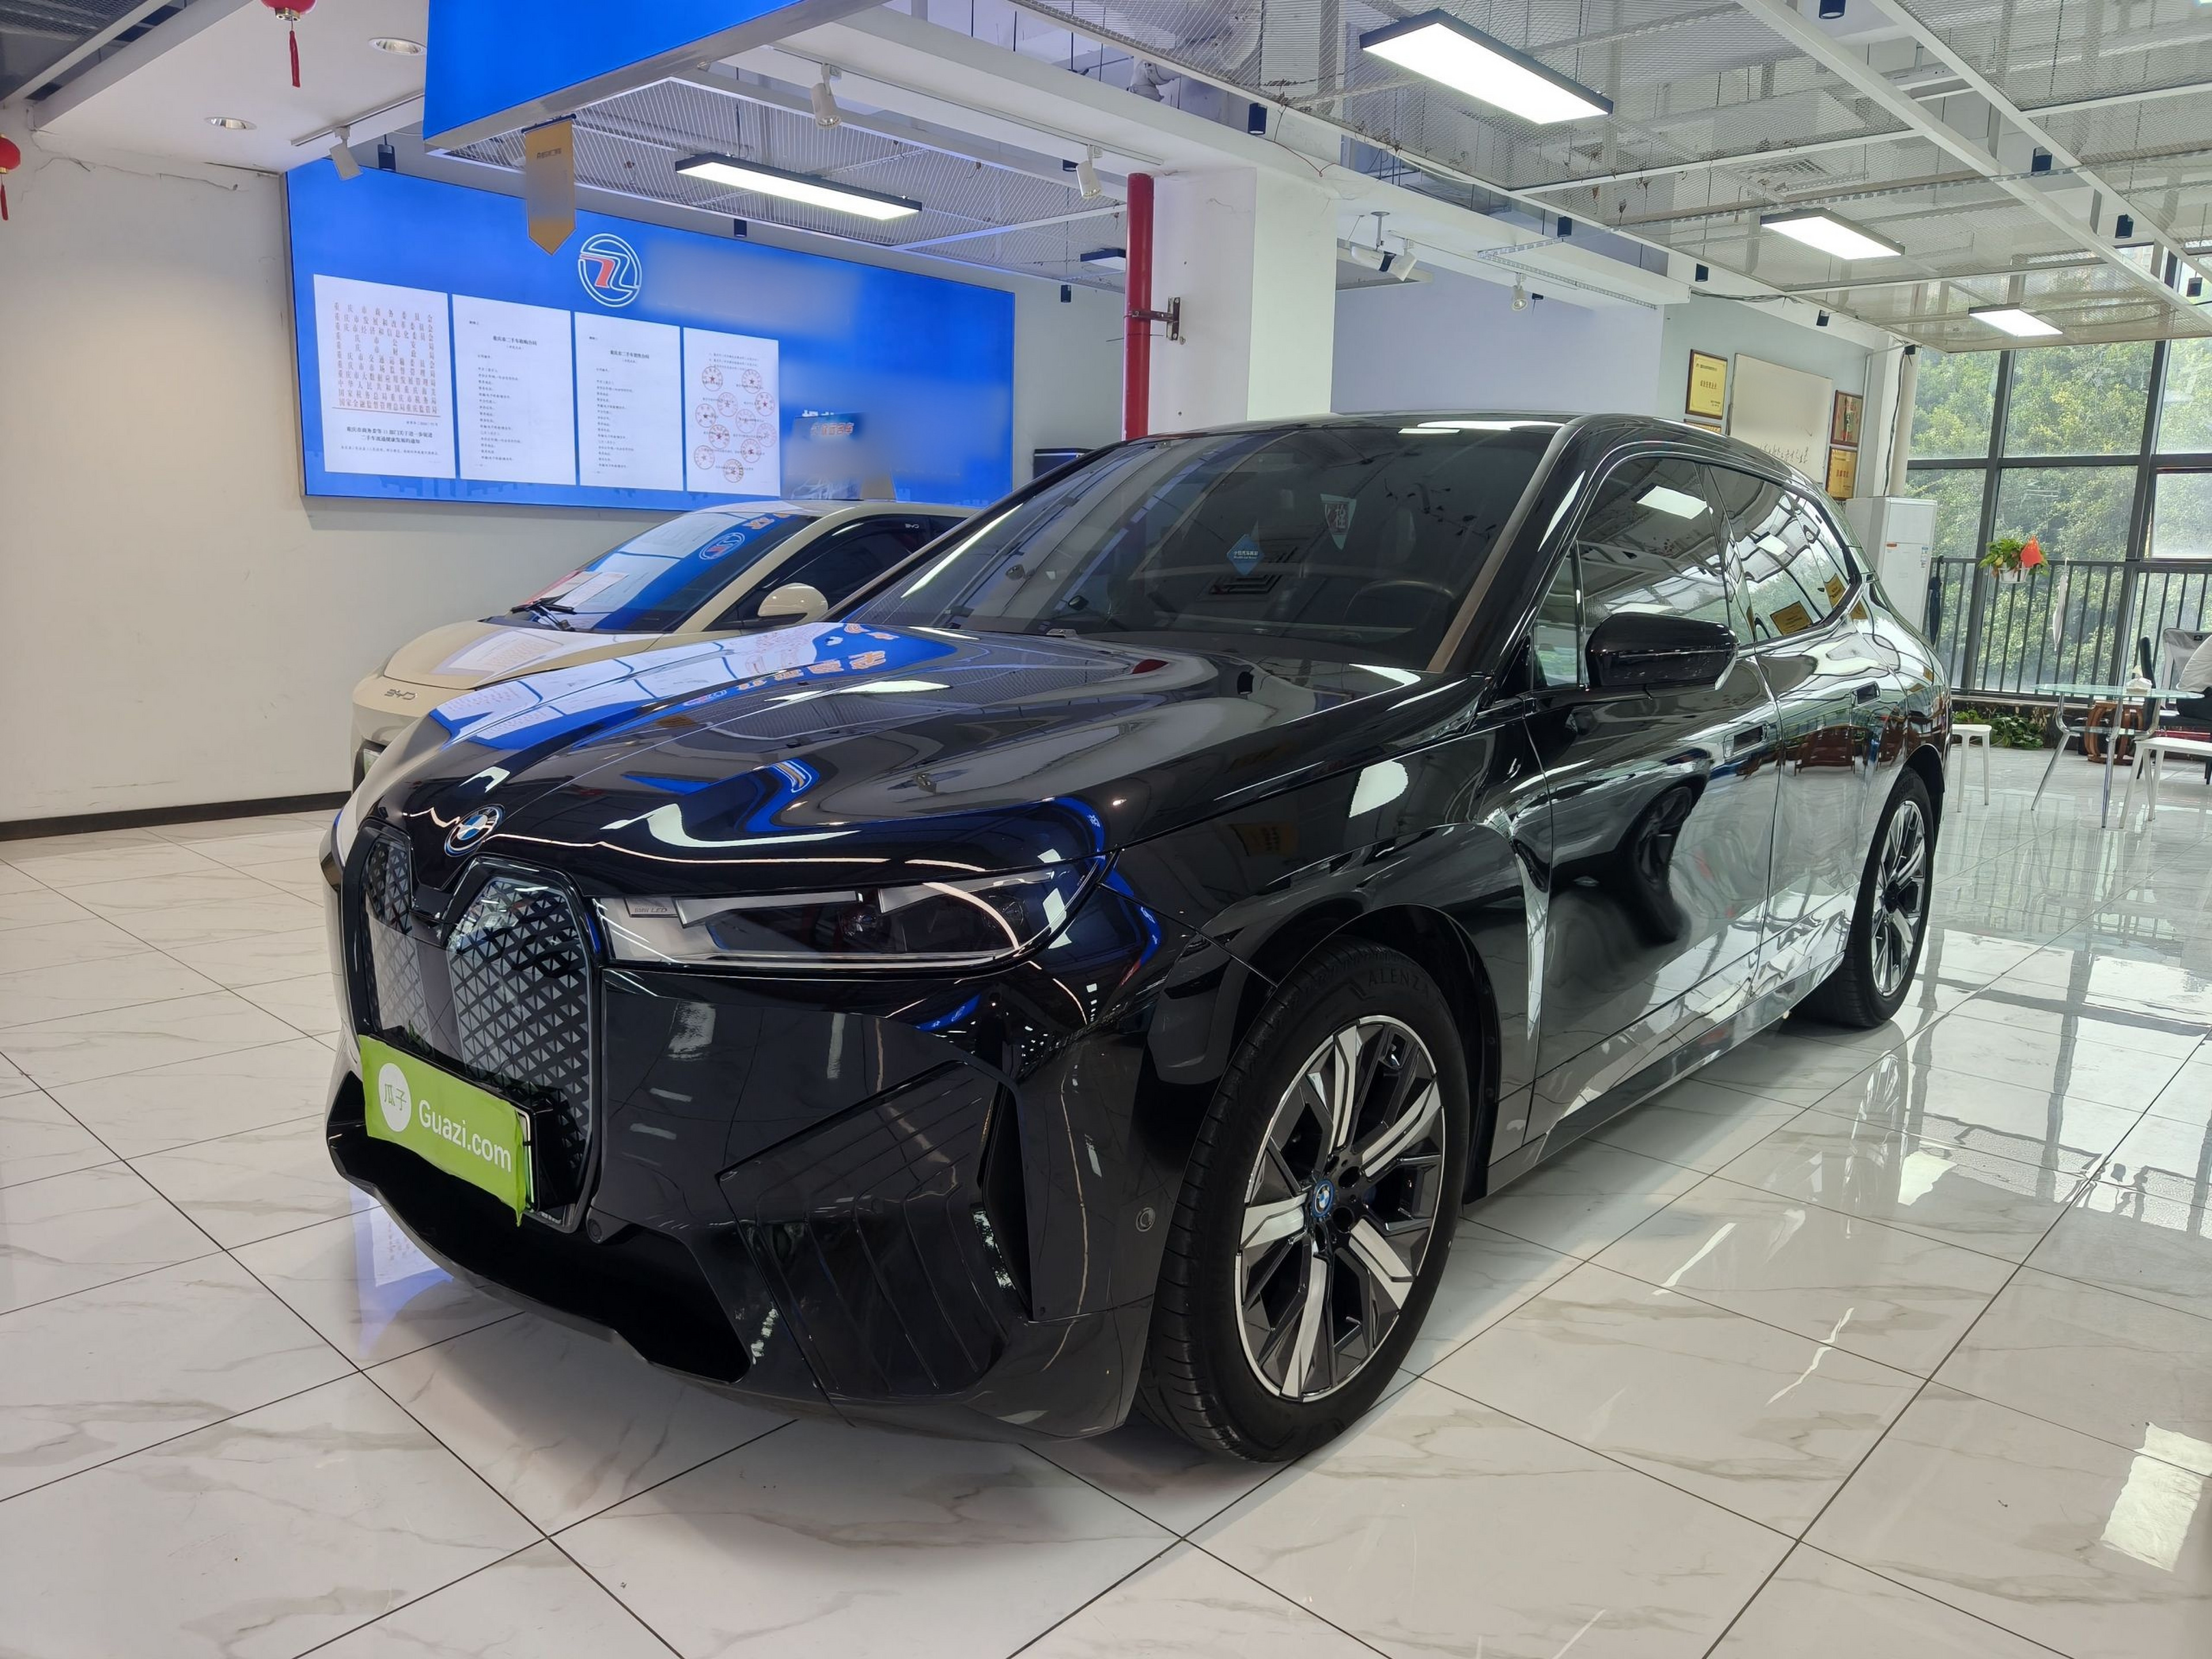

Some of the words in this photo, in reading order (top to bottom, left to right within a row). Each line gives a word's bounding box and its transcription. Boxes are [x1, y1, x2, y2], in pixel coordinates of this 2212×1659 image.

[335, 302, 433, 323] 重庆市商务委员会
[1369, 968, 1431, 1001] ALENZA
[384, 1085, 408, 1112] 瓜子
[419, 1099, 512, 1173] Guazi.com
